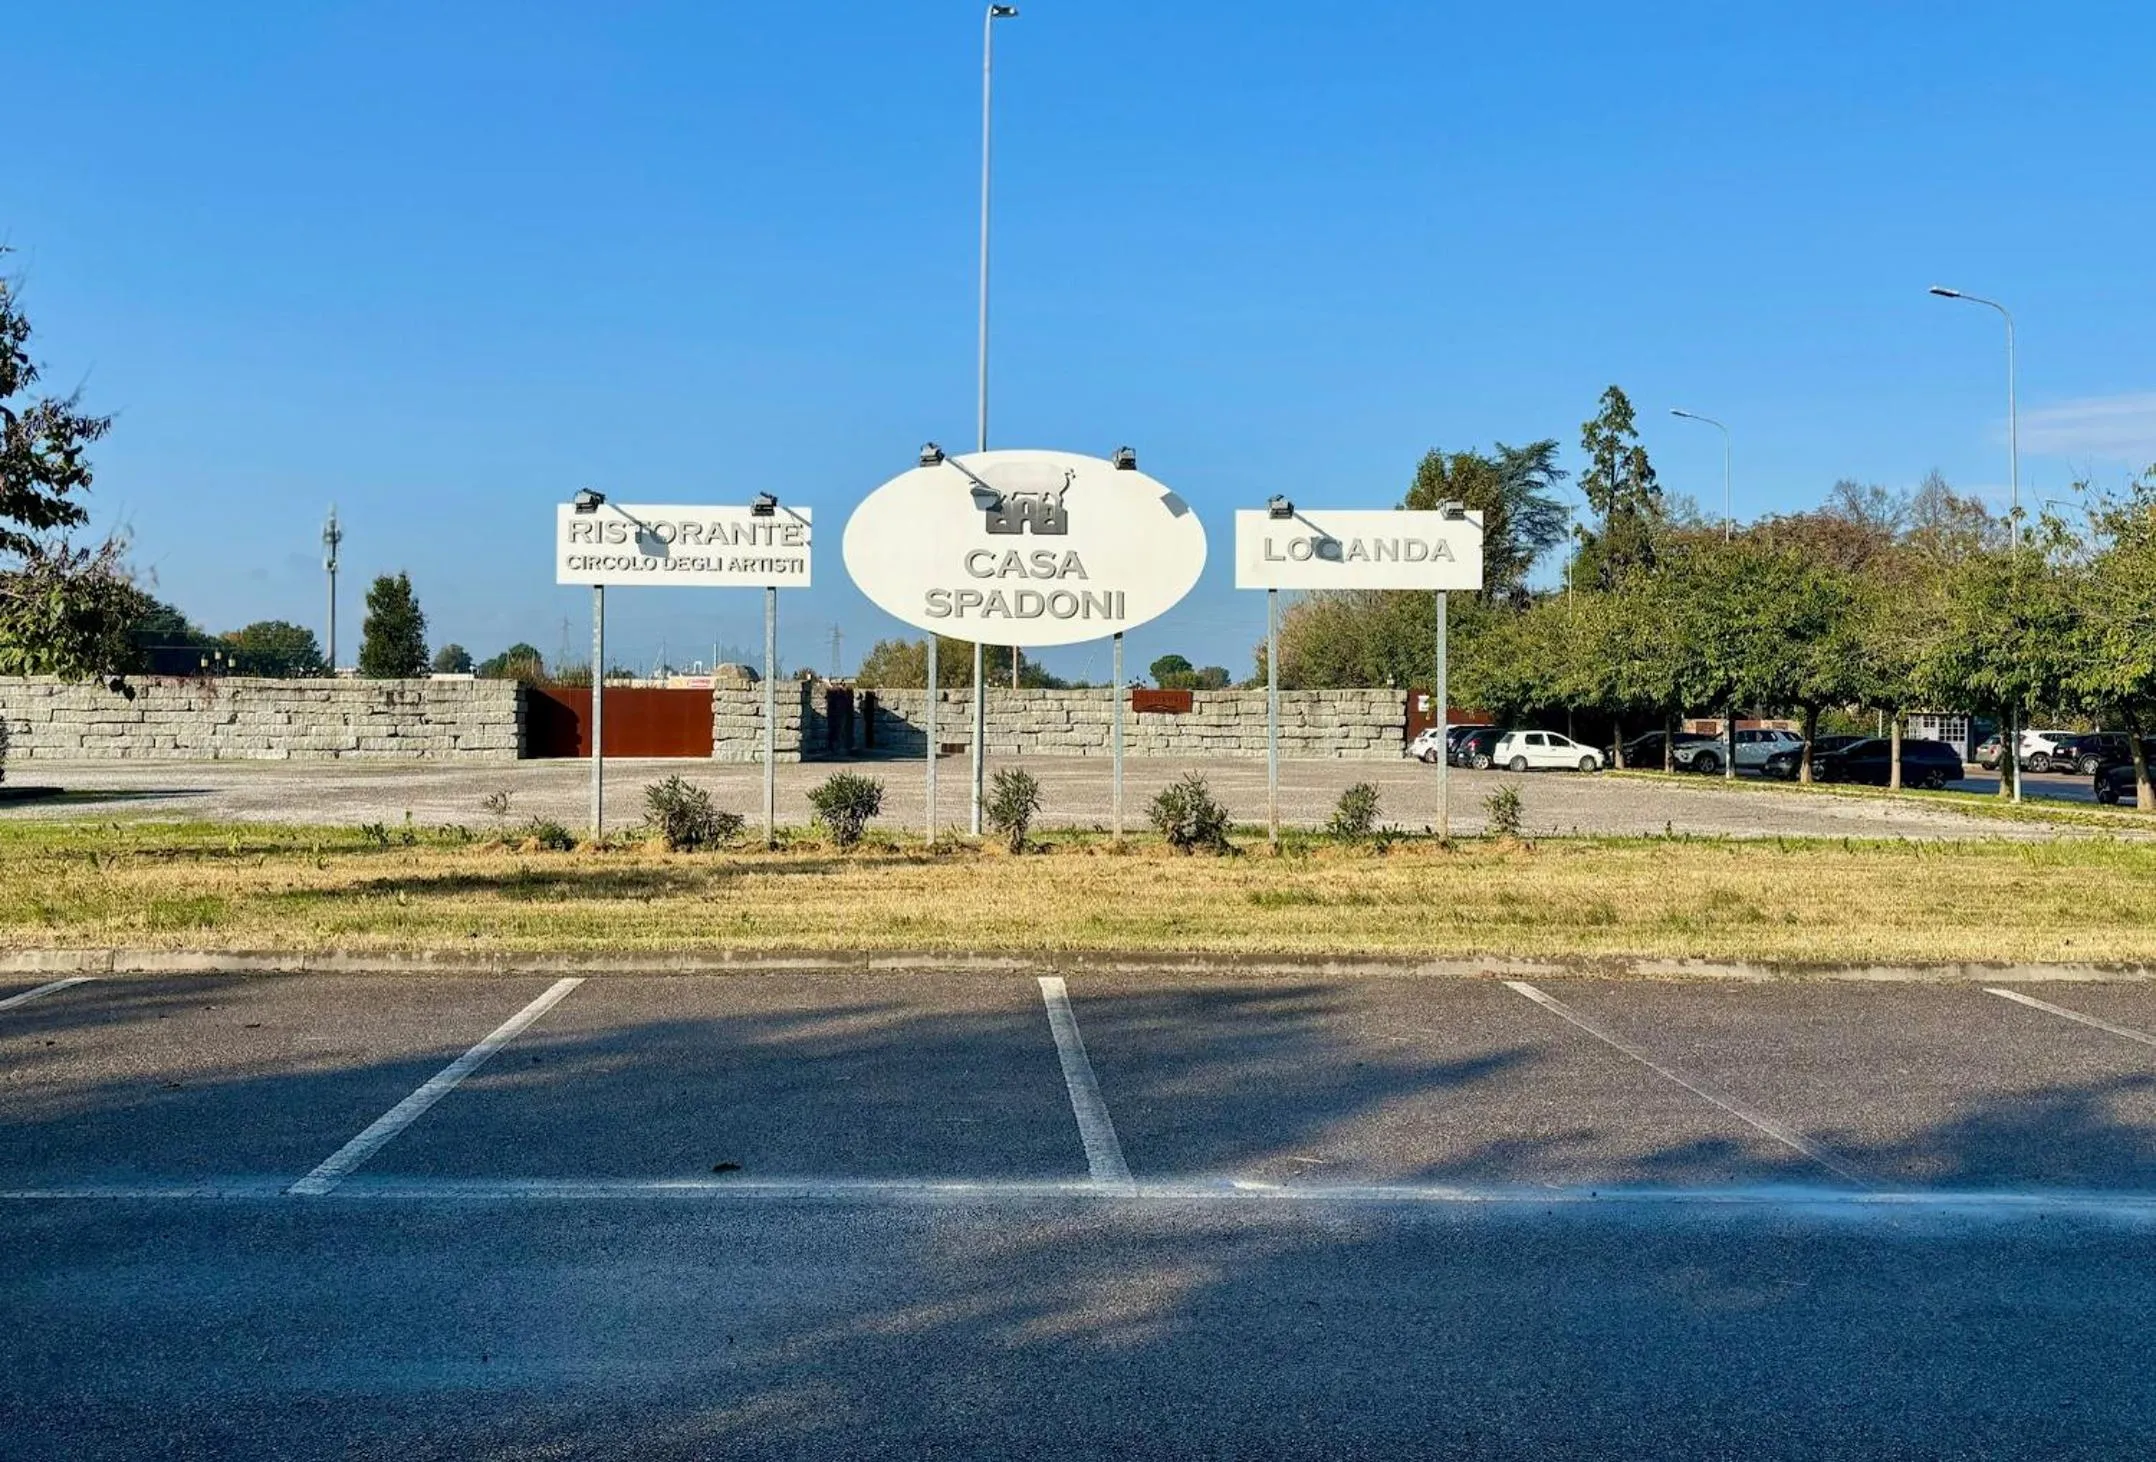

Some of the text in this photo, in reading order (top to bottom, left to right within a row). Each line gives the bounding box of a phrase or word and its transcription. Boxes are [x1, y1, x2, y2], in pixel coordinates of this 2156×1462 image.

[567, 519, 804, 547] RISTORANTE
[1264, 536, 1456, 562] LOCANDA
[567, 555, 804, 574] CIRCOLO DEGLI ARTISTI
[964, 549, 1089, 580] CASA
[924, 588, 1126, 619] SPADONI
